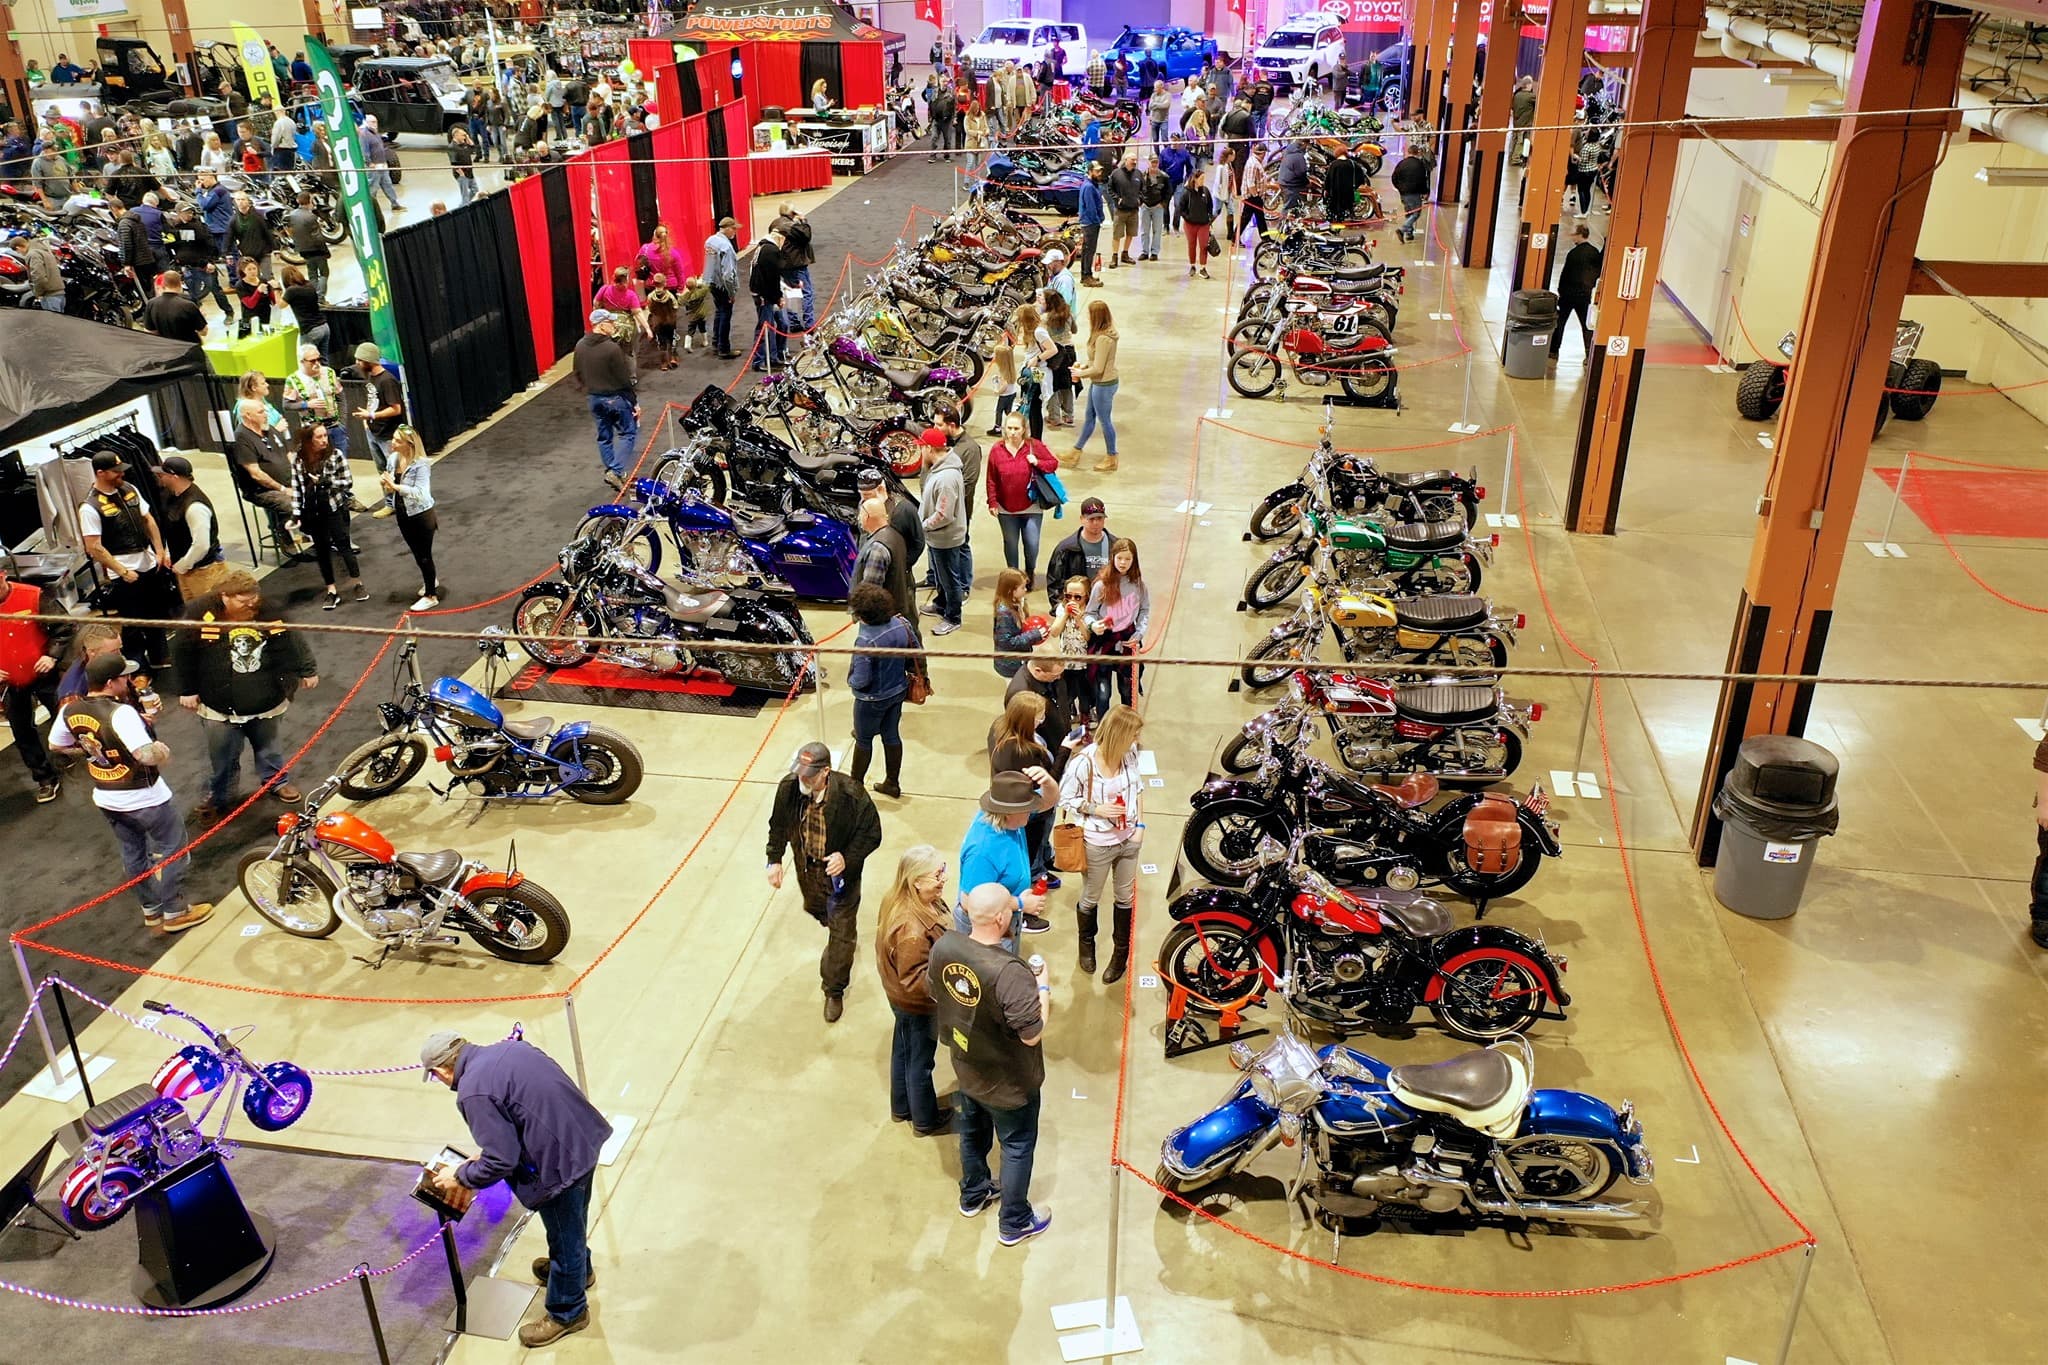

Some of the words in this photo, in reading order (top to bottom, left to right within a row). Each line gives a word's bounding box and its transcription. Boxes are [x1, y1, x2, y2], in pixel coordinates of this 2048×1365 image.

[704, 6, 821, 17] SPOKANE
[686, 16, 832, 31] POWERSPORTS
[1384, 14, 1401, 22] Plac
[811, 137, 850, 149] dweiser
[831, 158, 855, 167] IKERS
[1333, 315, 1355, 333] 61
